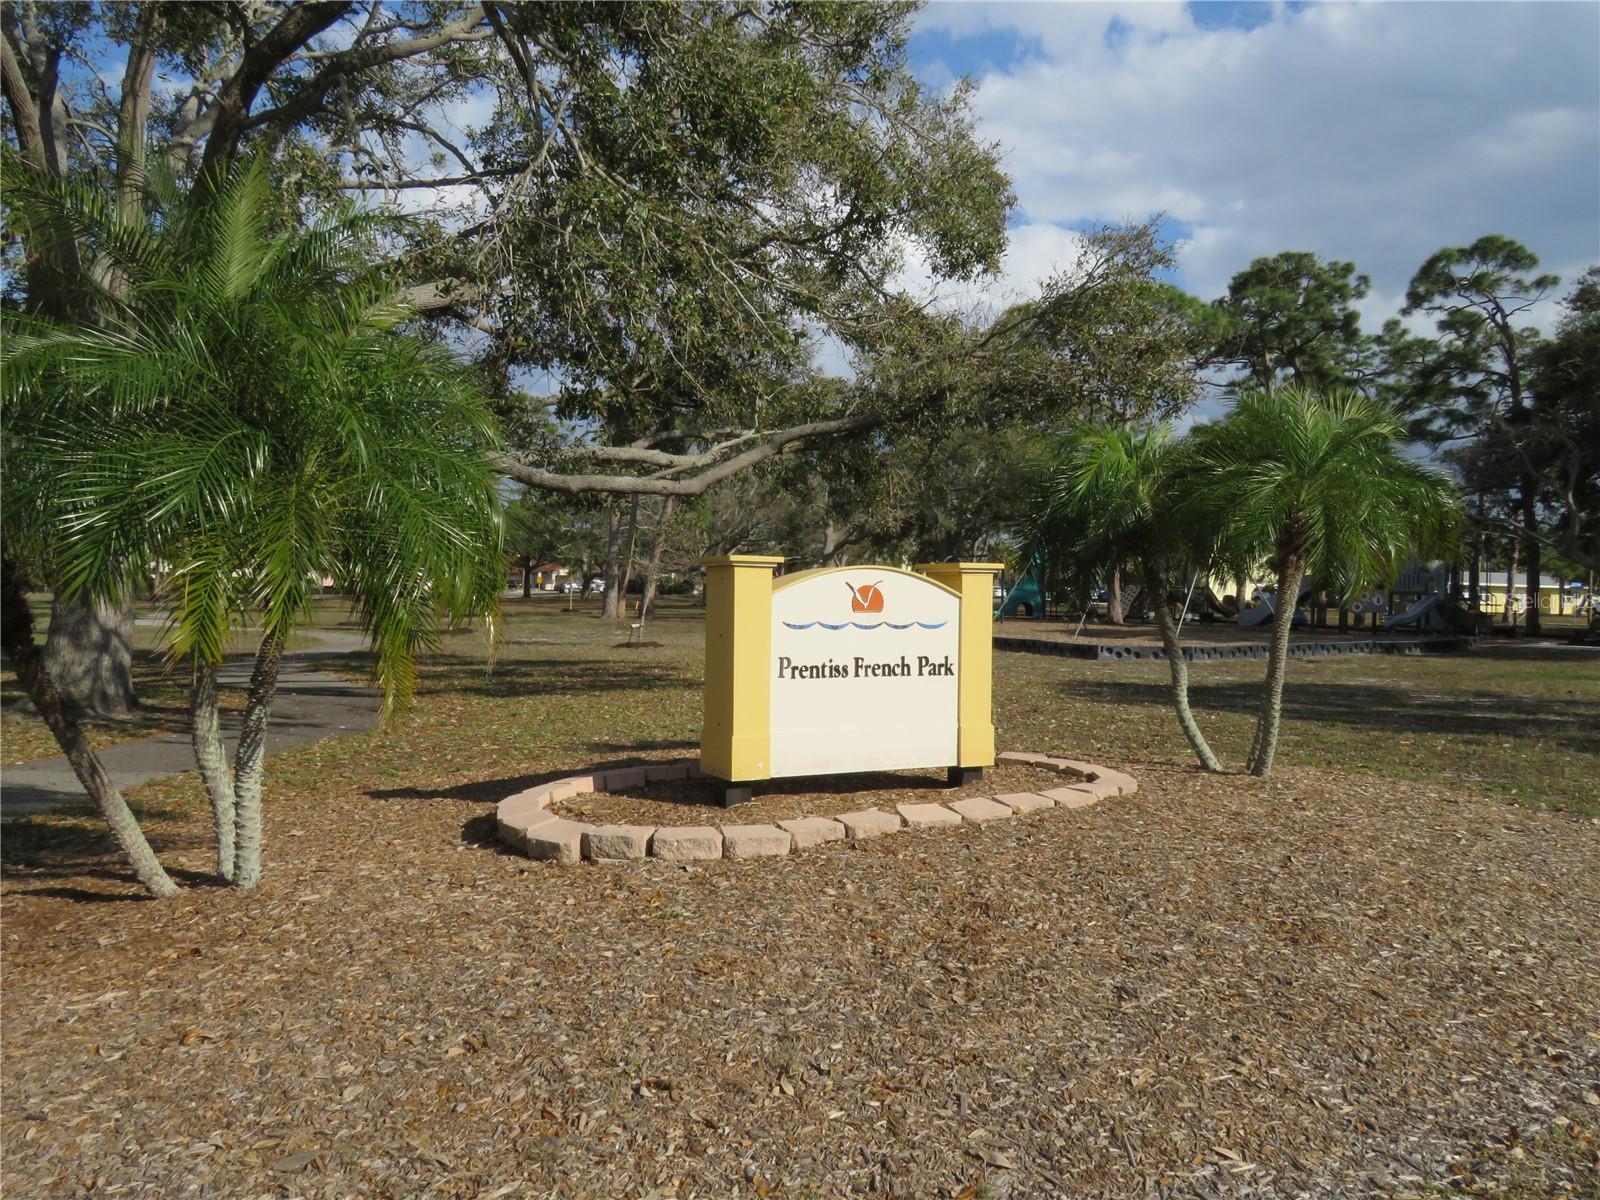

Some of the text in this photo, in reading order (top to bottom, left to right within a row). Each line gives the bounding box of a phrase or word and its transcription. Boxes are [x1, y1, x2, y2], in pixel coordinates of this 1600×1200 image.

[777, 655, 955, 680] Prentiss French Park
